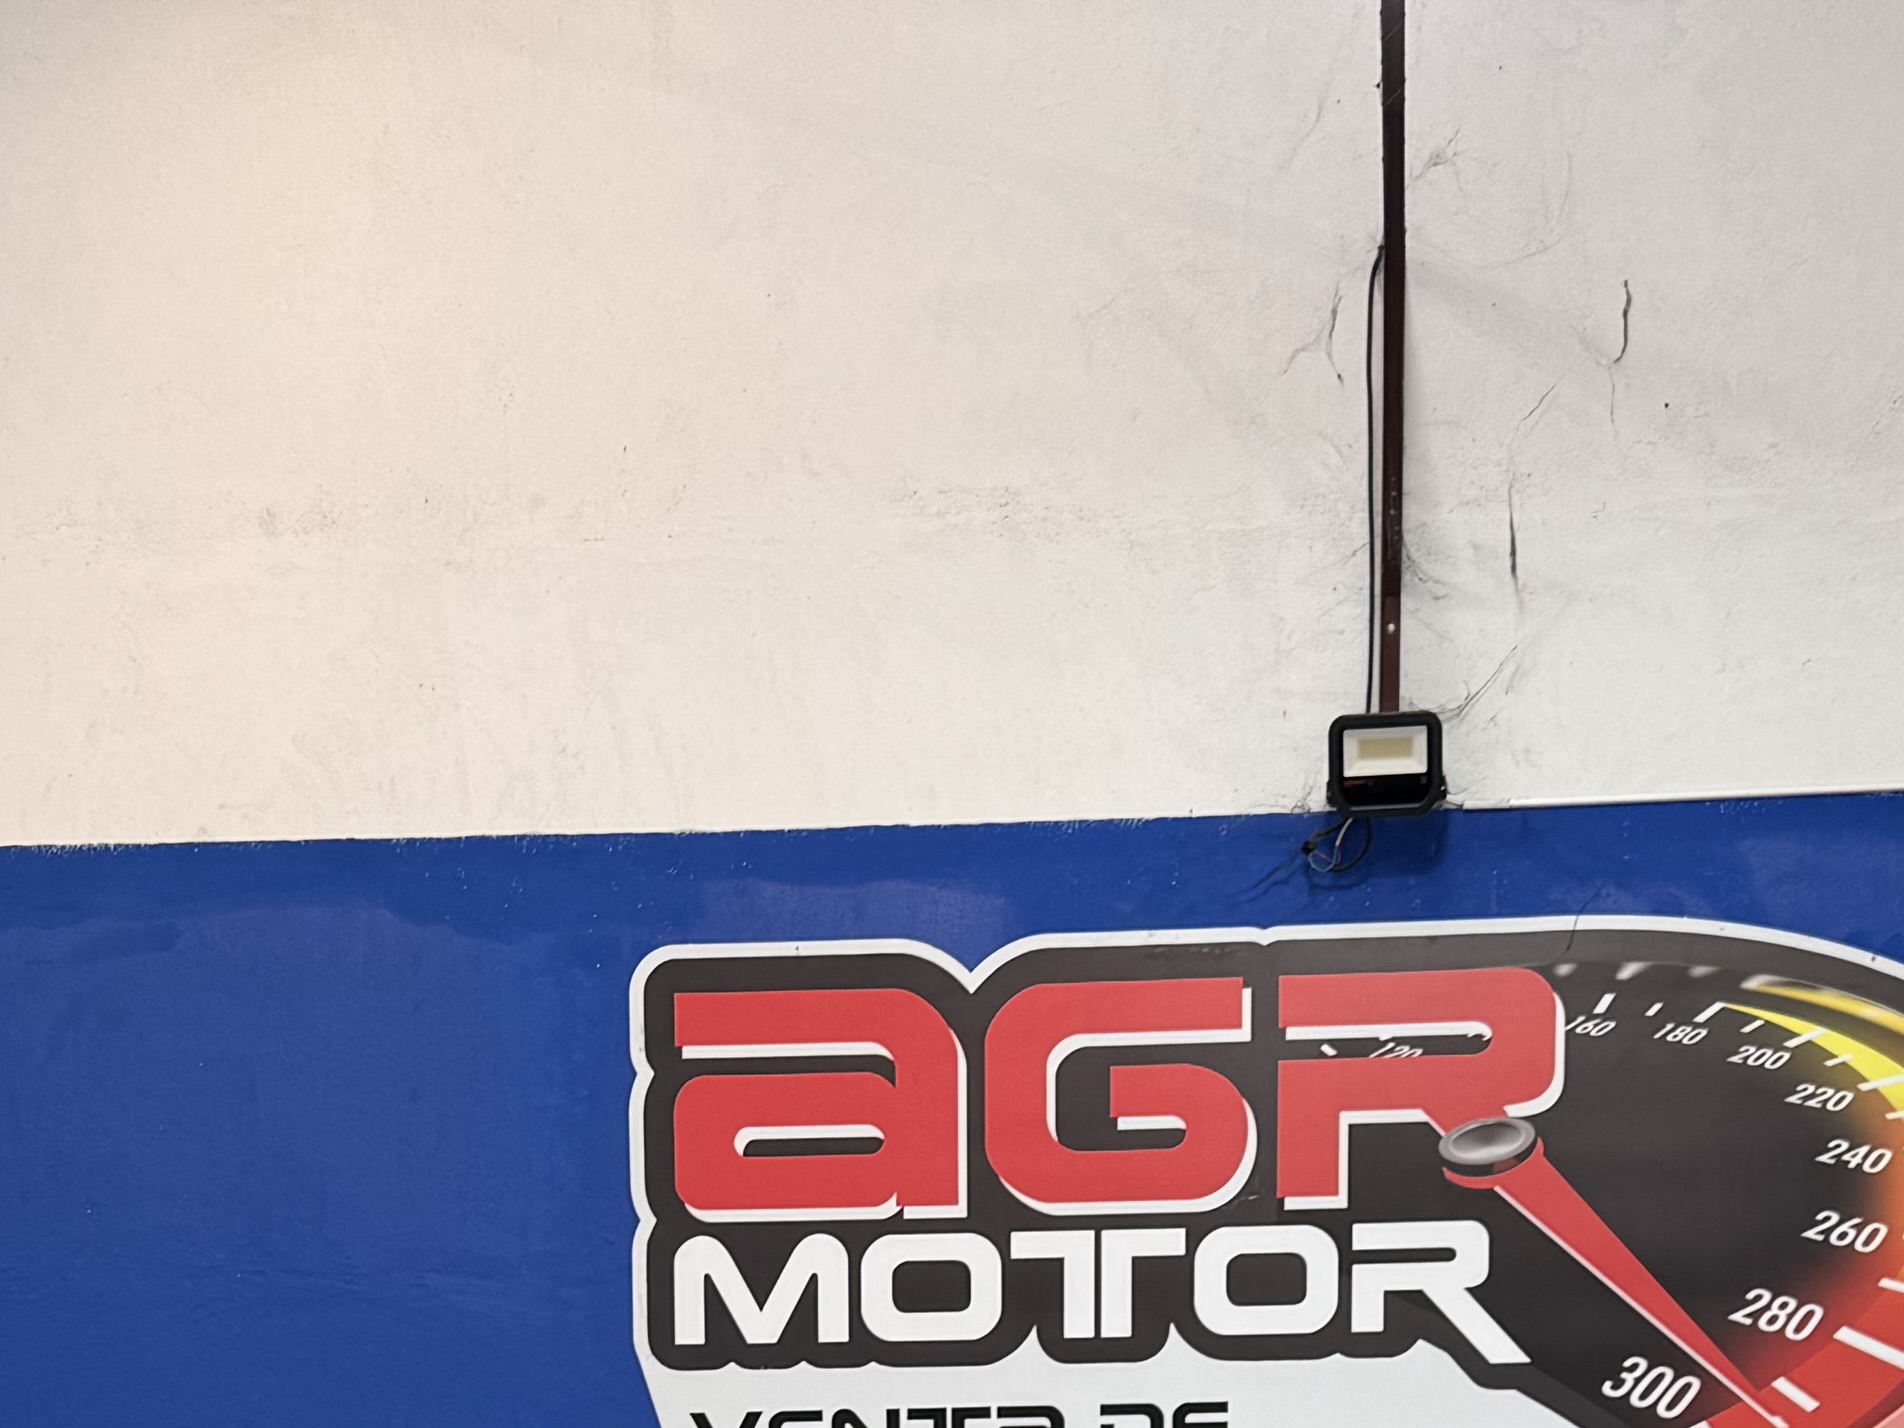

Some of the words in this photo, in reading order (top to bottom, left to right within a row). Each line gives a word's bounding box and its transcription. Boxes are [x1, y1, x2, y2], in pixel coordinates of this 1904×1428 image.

[1563, 1015, 1617, 1039] 160
[1653, 1020, 1709, 1046] 180
[1726, 1044, 1792, 1071] 200
[1784, 1082, 1855, 1112] 220
[1815, 1138, 1894, 1175] 240
[1801, 1209, 1890, 1254] 260
[673, 1219, 1533, 1365] MOTOR
[1727, 1287, 1826, 1342] 280
[1600, 1355, 1703, 1420] 300
